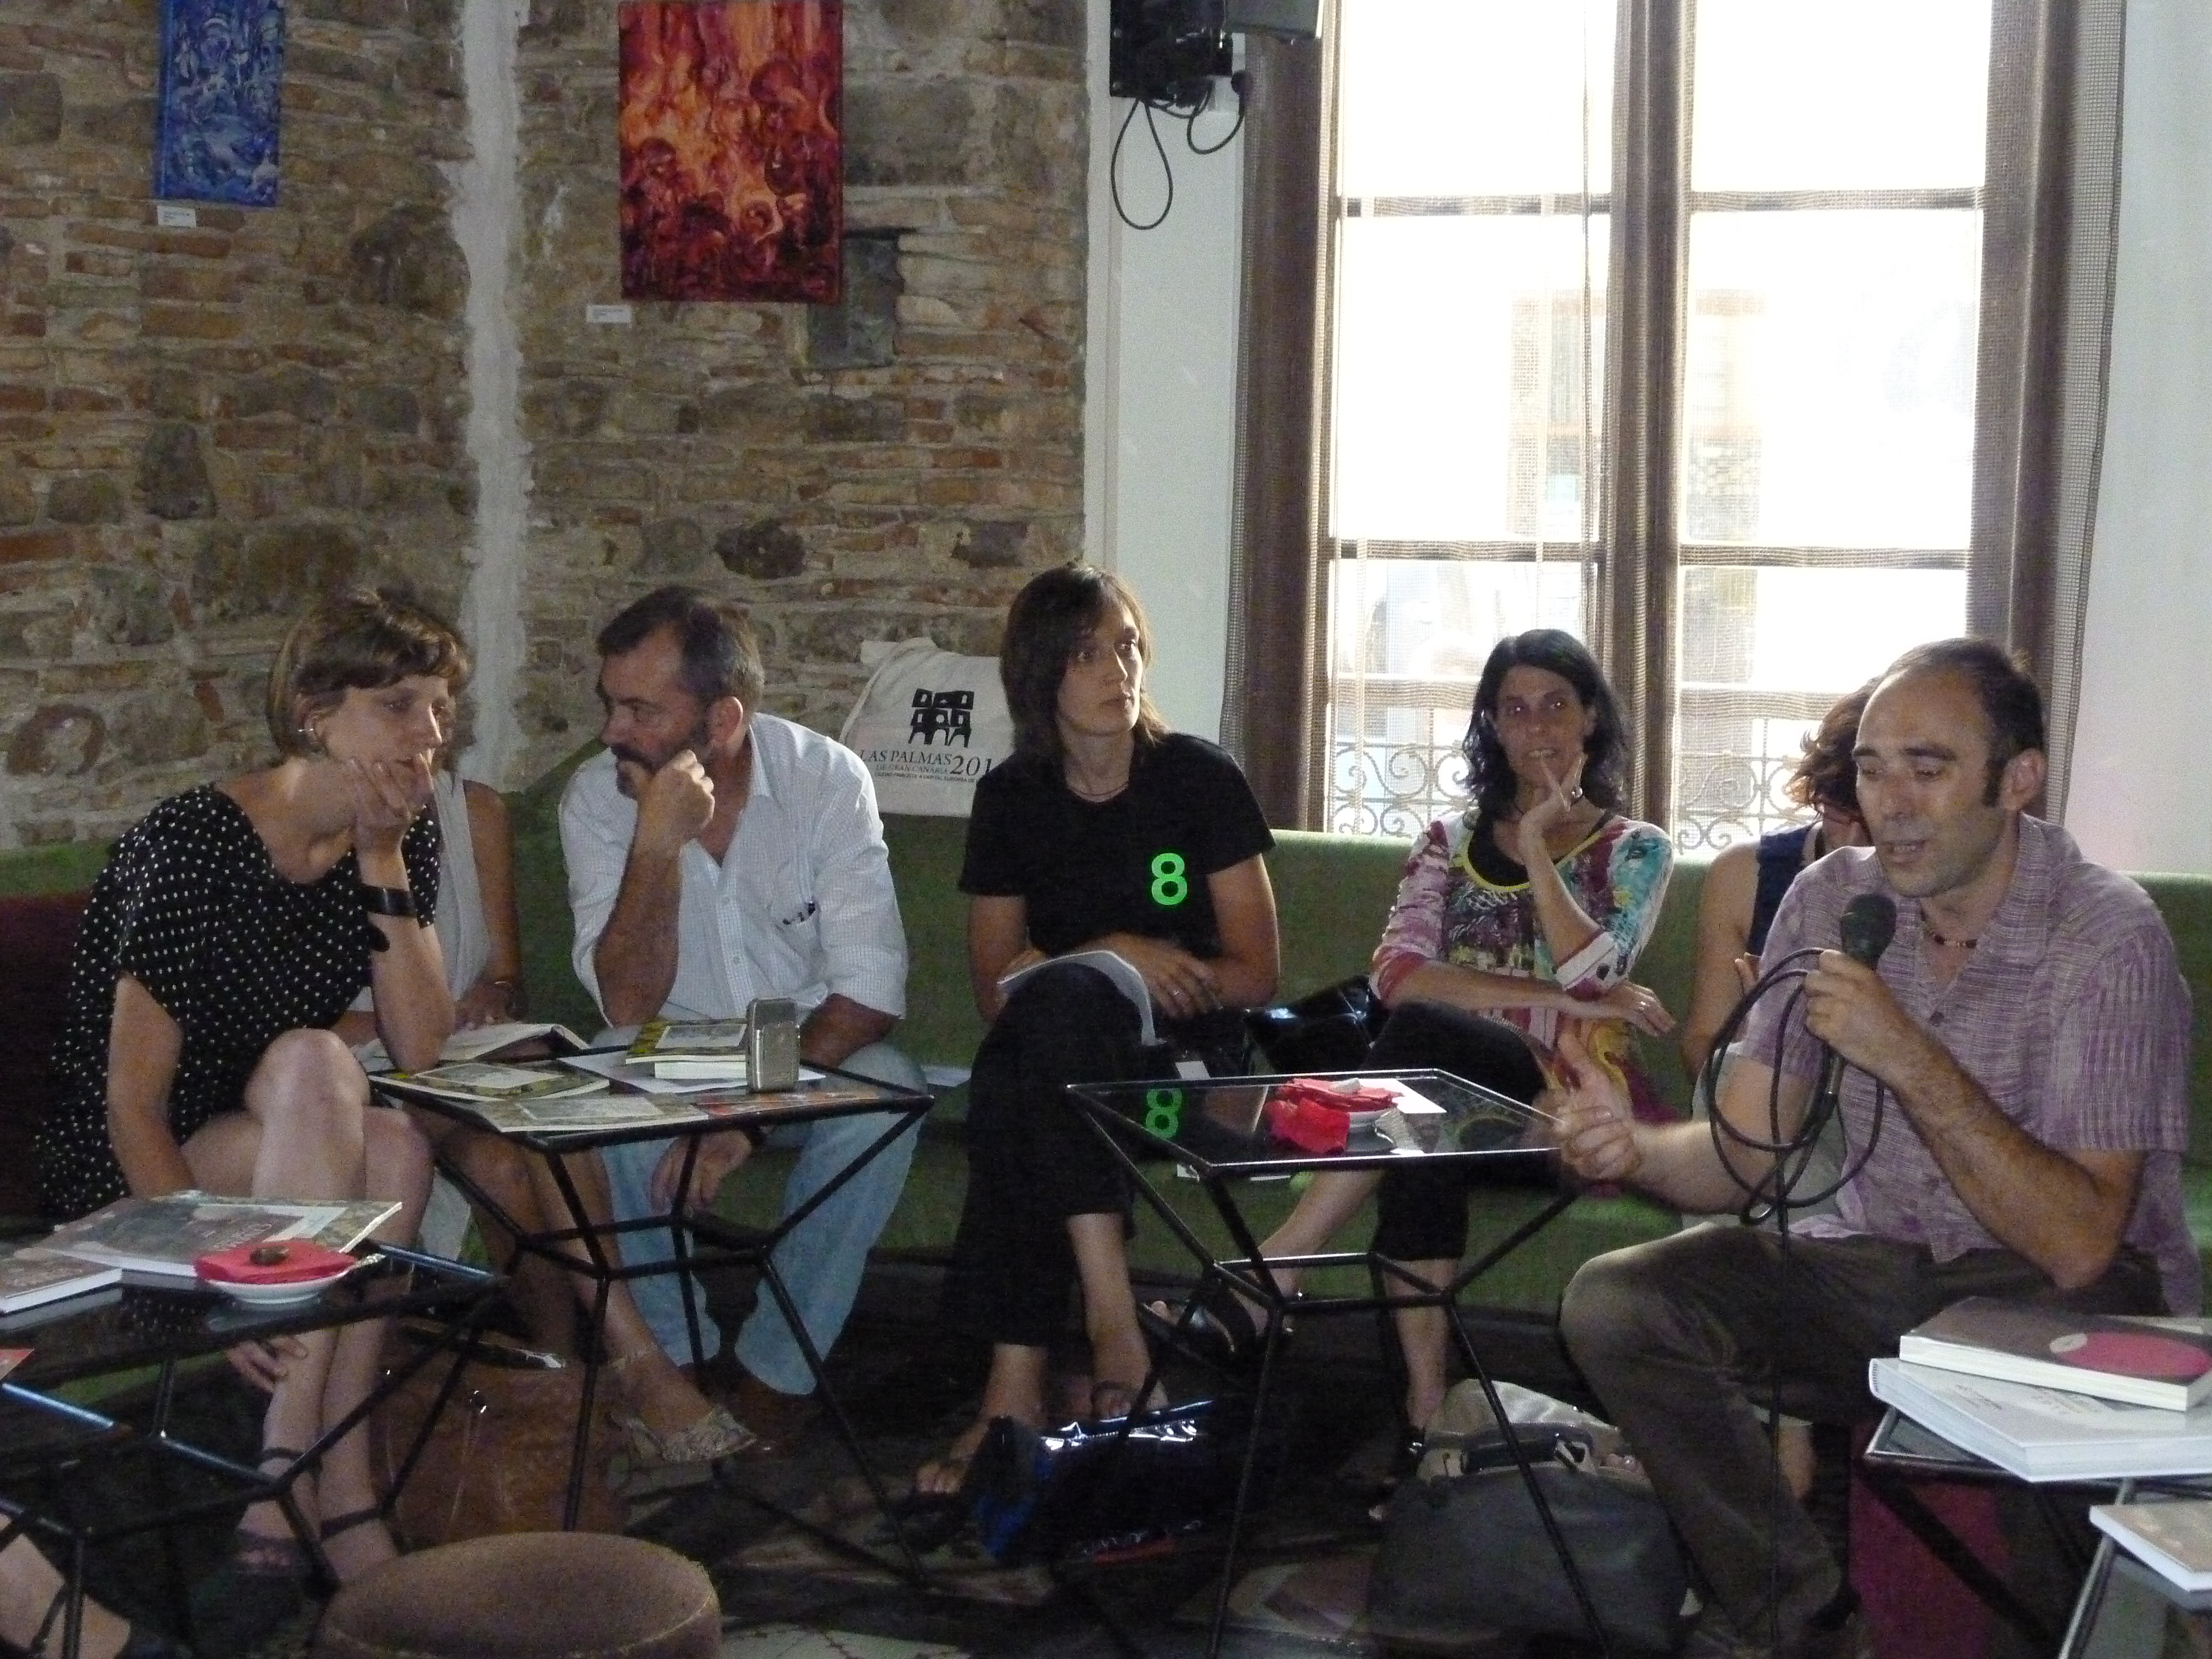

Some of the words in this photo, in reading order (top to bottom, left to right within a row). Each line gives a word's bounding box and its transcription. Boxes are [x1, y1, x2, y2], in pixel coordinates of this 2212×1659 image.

[860, 749, 888, 762] LAS
[890, 750, 952, 766] PALMAS
[911, 765, 948, 774] CANARIA
[1151, 852, 1188, 906] 8
